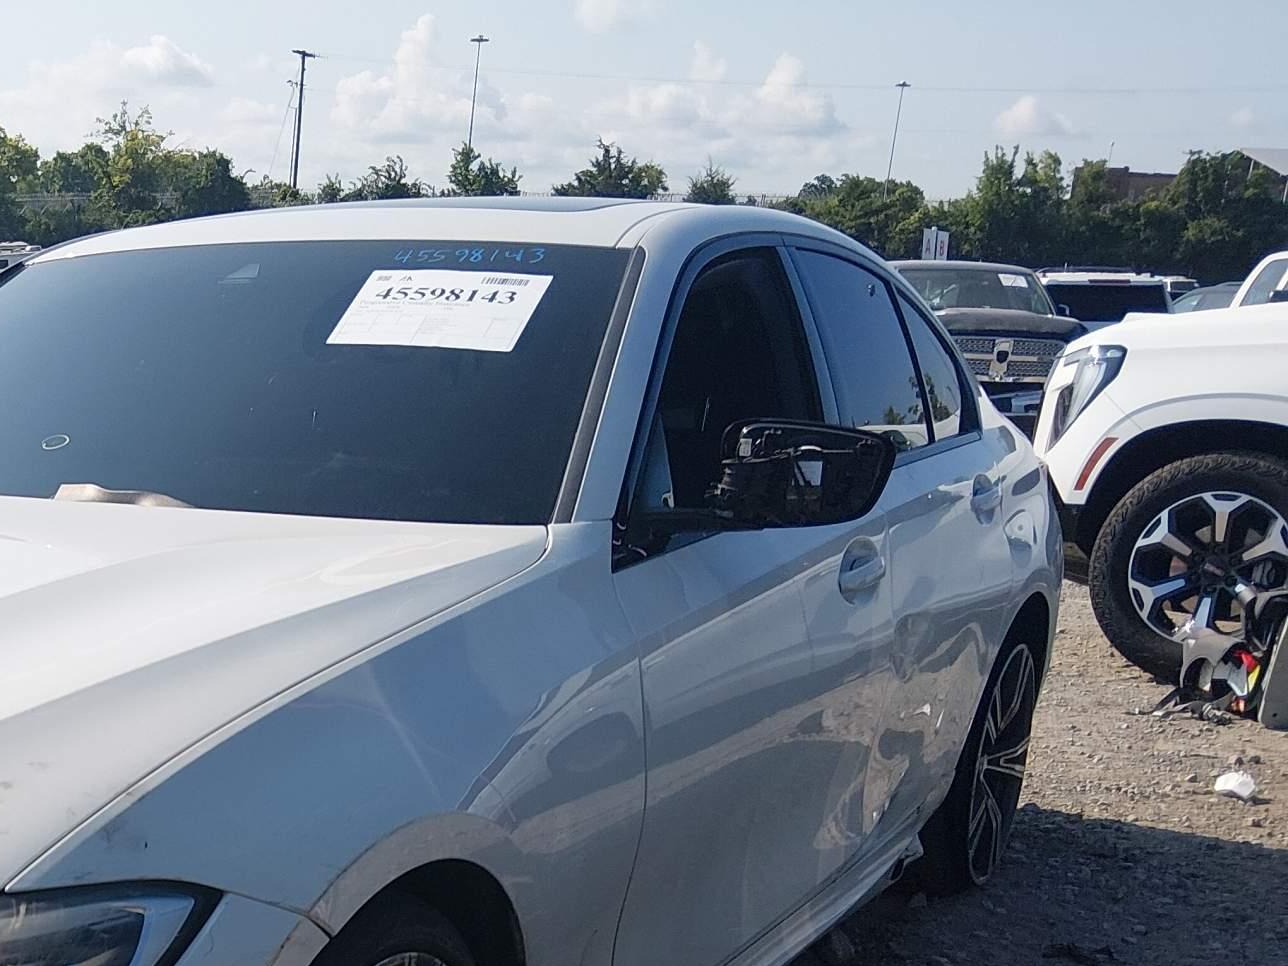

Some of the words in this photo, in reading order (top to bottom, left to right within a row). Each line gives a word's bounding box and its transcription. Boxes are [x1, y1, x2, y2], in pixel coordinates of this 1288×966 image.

[924, 238, 932, 255] A
[394, 248, 546, 264] 45598143
[375, 286, 518, 305] 45598143
